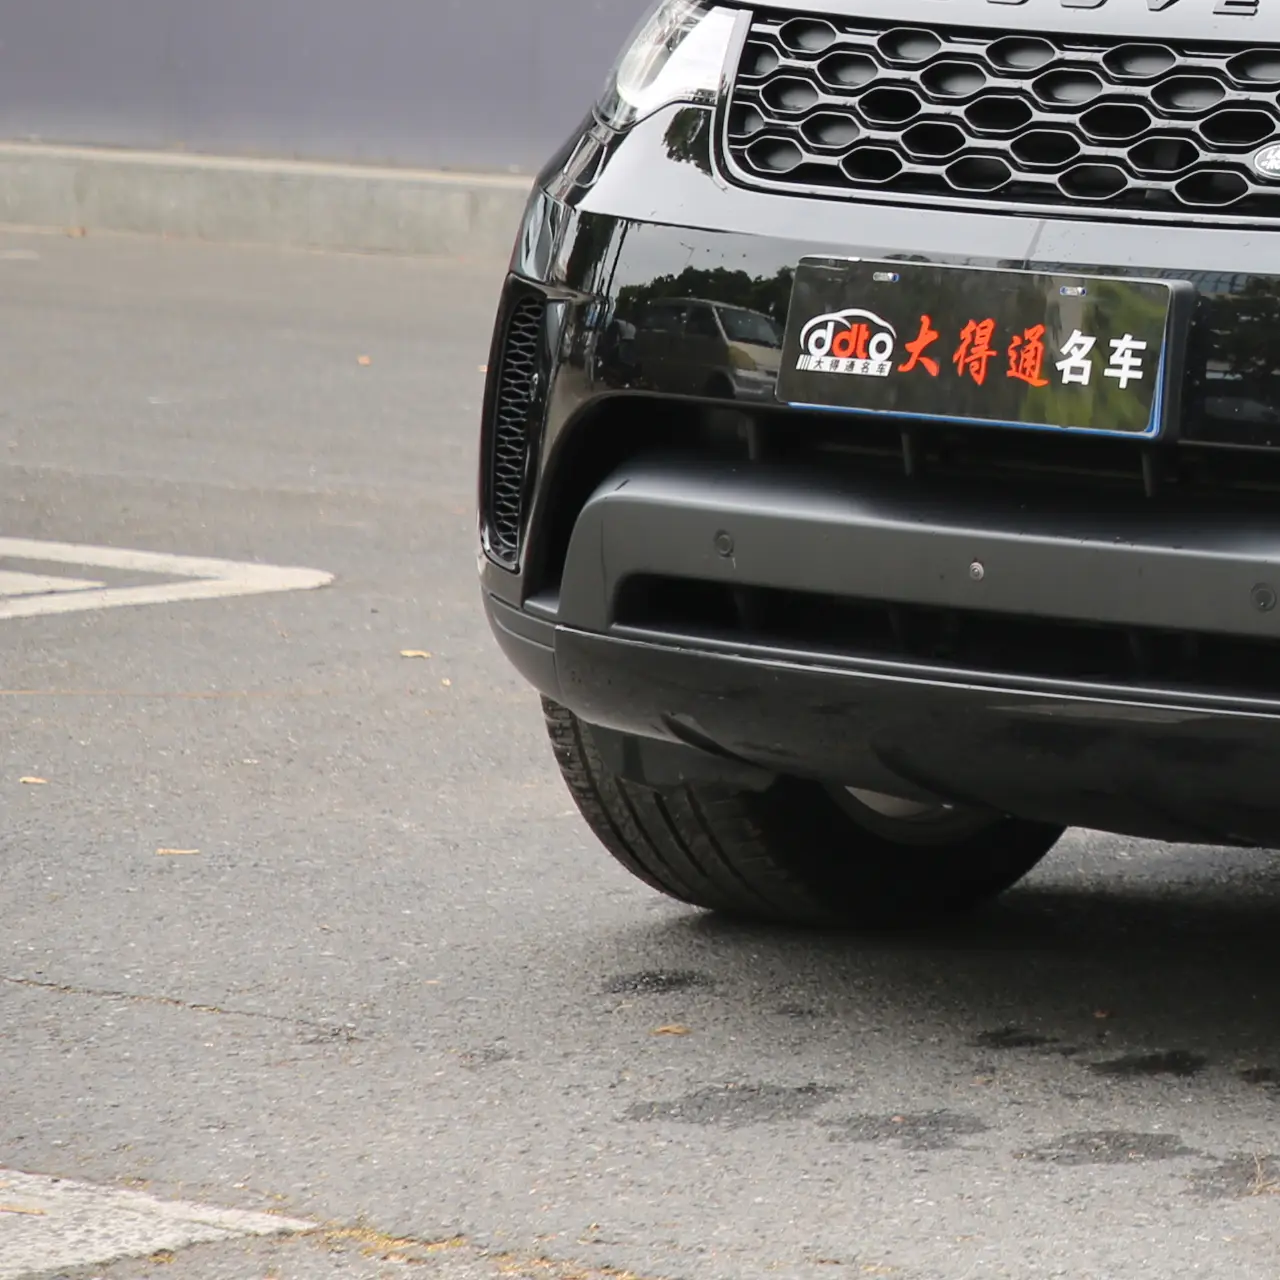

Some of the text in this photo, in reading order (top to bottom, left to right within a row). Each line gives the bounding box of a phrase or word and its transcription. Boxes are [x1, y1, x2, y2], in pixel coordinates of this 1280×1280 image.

[897, 314, 1147, 389] 大得通名车
